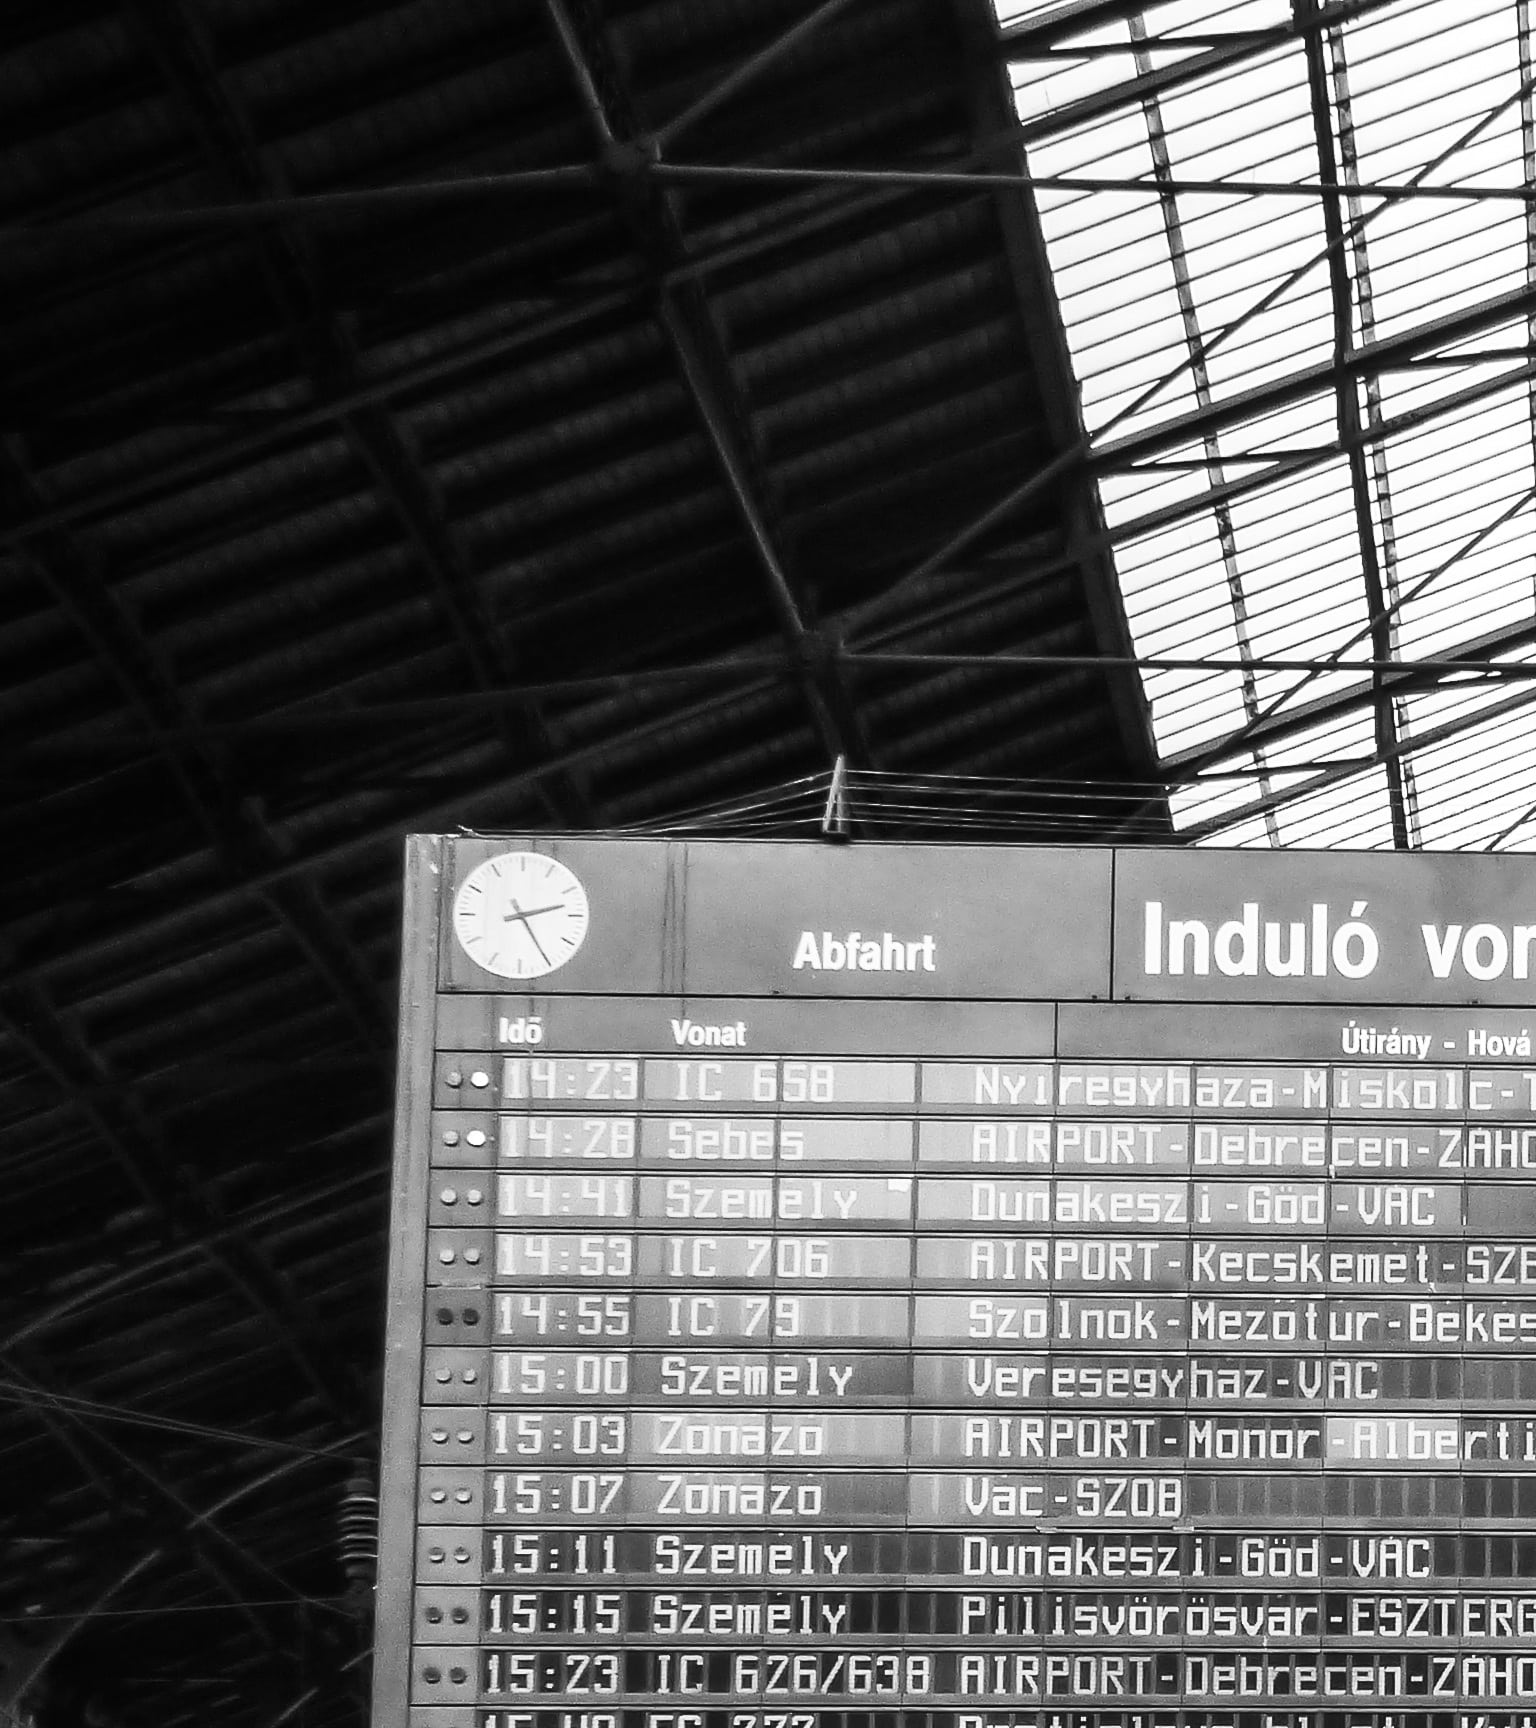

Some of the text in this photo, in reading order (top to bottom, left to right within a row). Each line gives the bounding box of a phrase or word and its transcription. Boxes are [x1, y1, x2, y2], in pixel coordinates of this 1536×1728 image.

[792, 932, 936, 974] Abfahrt
[1144, 901, 1379, 979] Induló
[500, 1018, 543, 1046] Idő
[672, 1018, 746, 1047] Vonat
[1341, 1021, 1530, 1061] Útirány Hová
[504, 1061, 635, 1101] 14:23
[671, 1063, 719, 1102] IC
[749, 1064, 830, 1103] 658
[502, 1120, 634, 1159] 14:28
[665, 1122, 801, 1161] Sebes
[500, 1178, 627, 1218] 14:41
[498, 1237, 631, 1276] 14:53
[667, 1239, 714, 1277] IC
[745, 1239, 826, 1278] 706
[497, 1296, 629, 1335] 14:55
[665, 1297, 713, 1336] IC
[744, 1298, 797, 1337] 79
[495, 1355, 627, 1394] 15:00
[493, 1414, 626, 1454] 15:03
[491, 1474, 624, 1513] 15:07
[490, 1533, 618, 1572] 15:11
[488, 1593, 621, 1632] 15:15
[486, 1653, 619, 1692] 15:23
[656, 1653, 704, 1692] IC
[735, 1654, 929, 1693] 626/638
